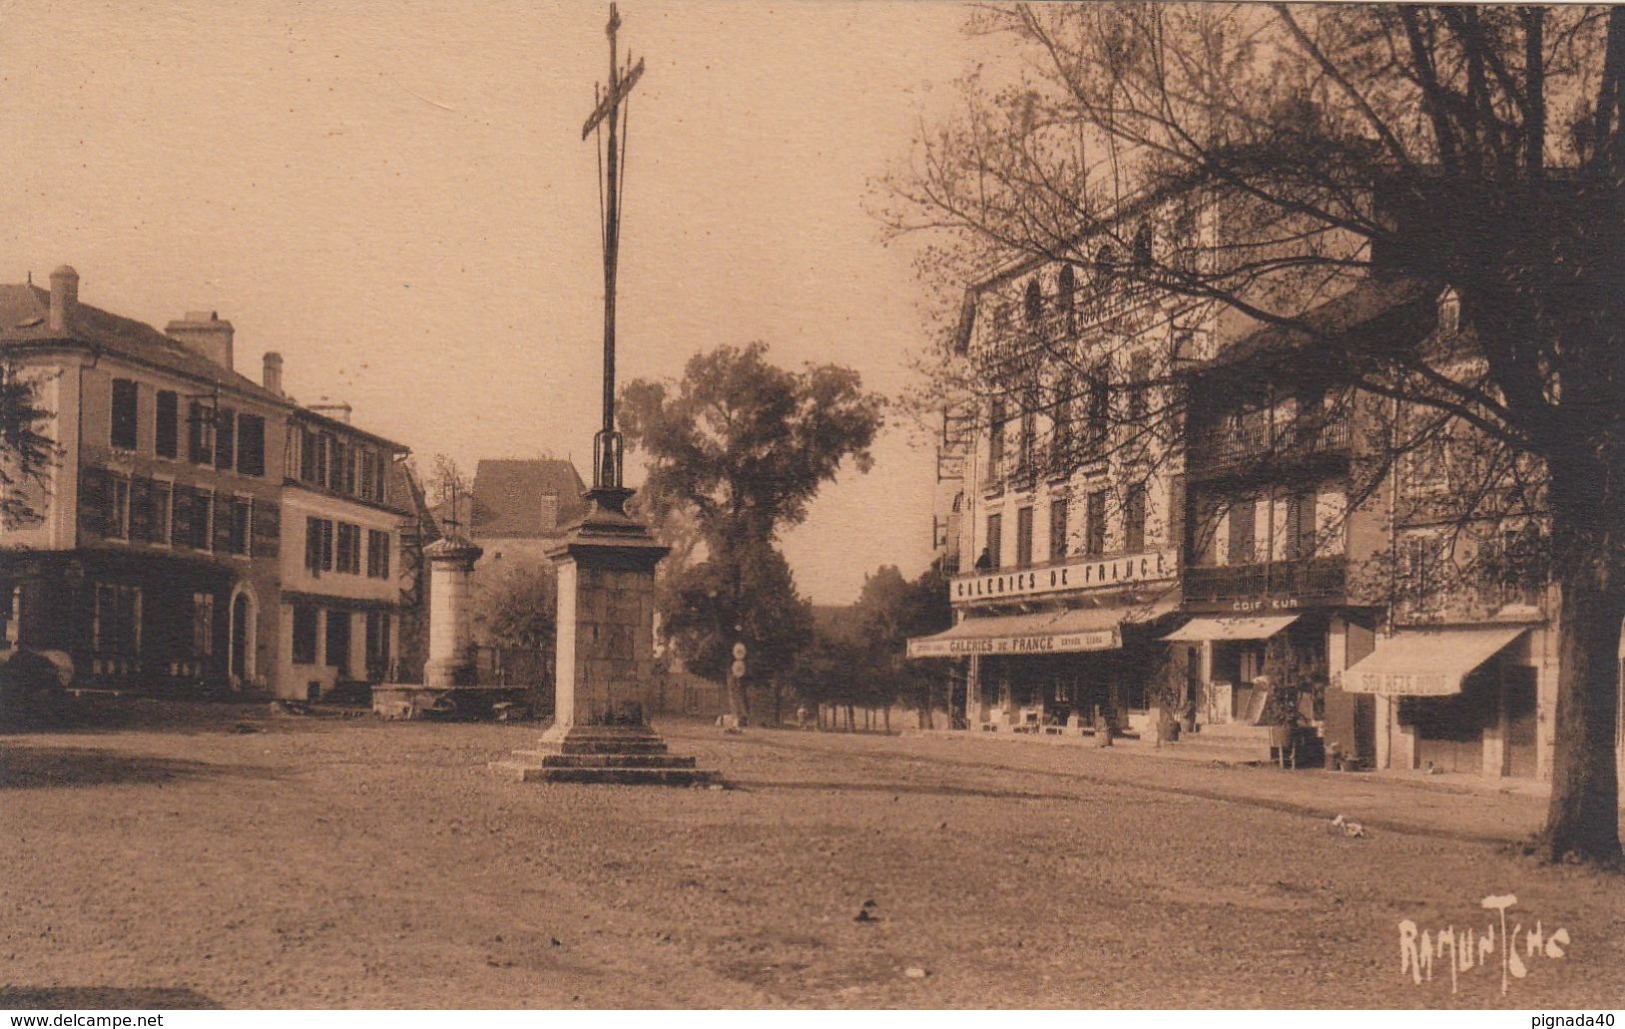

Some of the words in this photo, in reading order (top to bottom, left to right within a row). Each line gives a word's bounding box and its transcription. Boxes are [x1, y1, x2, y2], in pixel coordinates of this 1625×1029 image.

[1050, 568, 1069, 587] DE
[1085, 552, 1165, 584] FRANCE
[1232, 598, 1298, 612] COIFEUR
[949, 638, 993, 653] GALERIES
[1012, 636, 1054, 651] FRANCE
